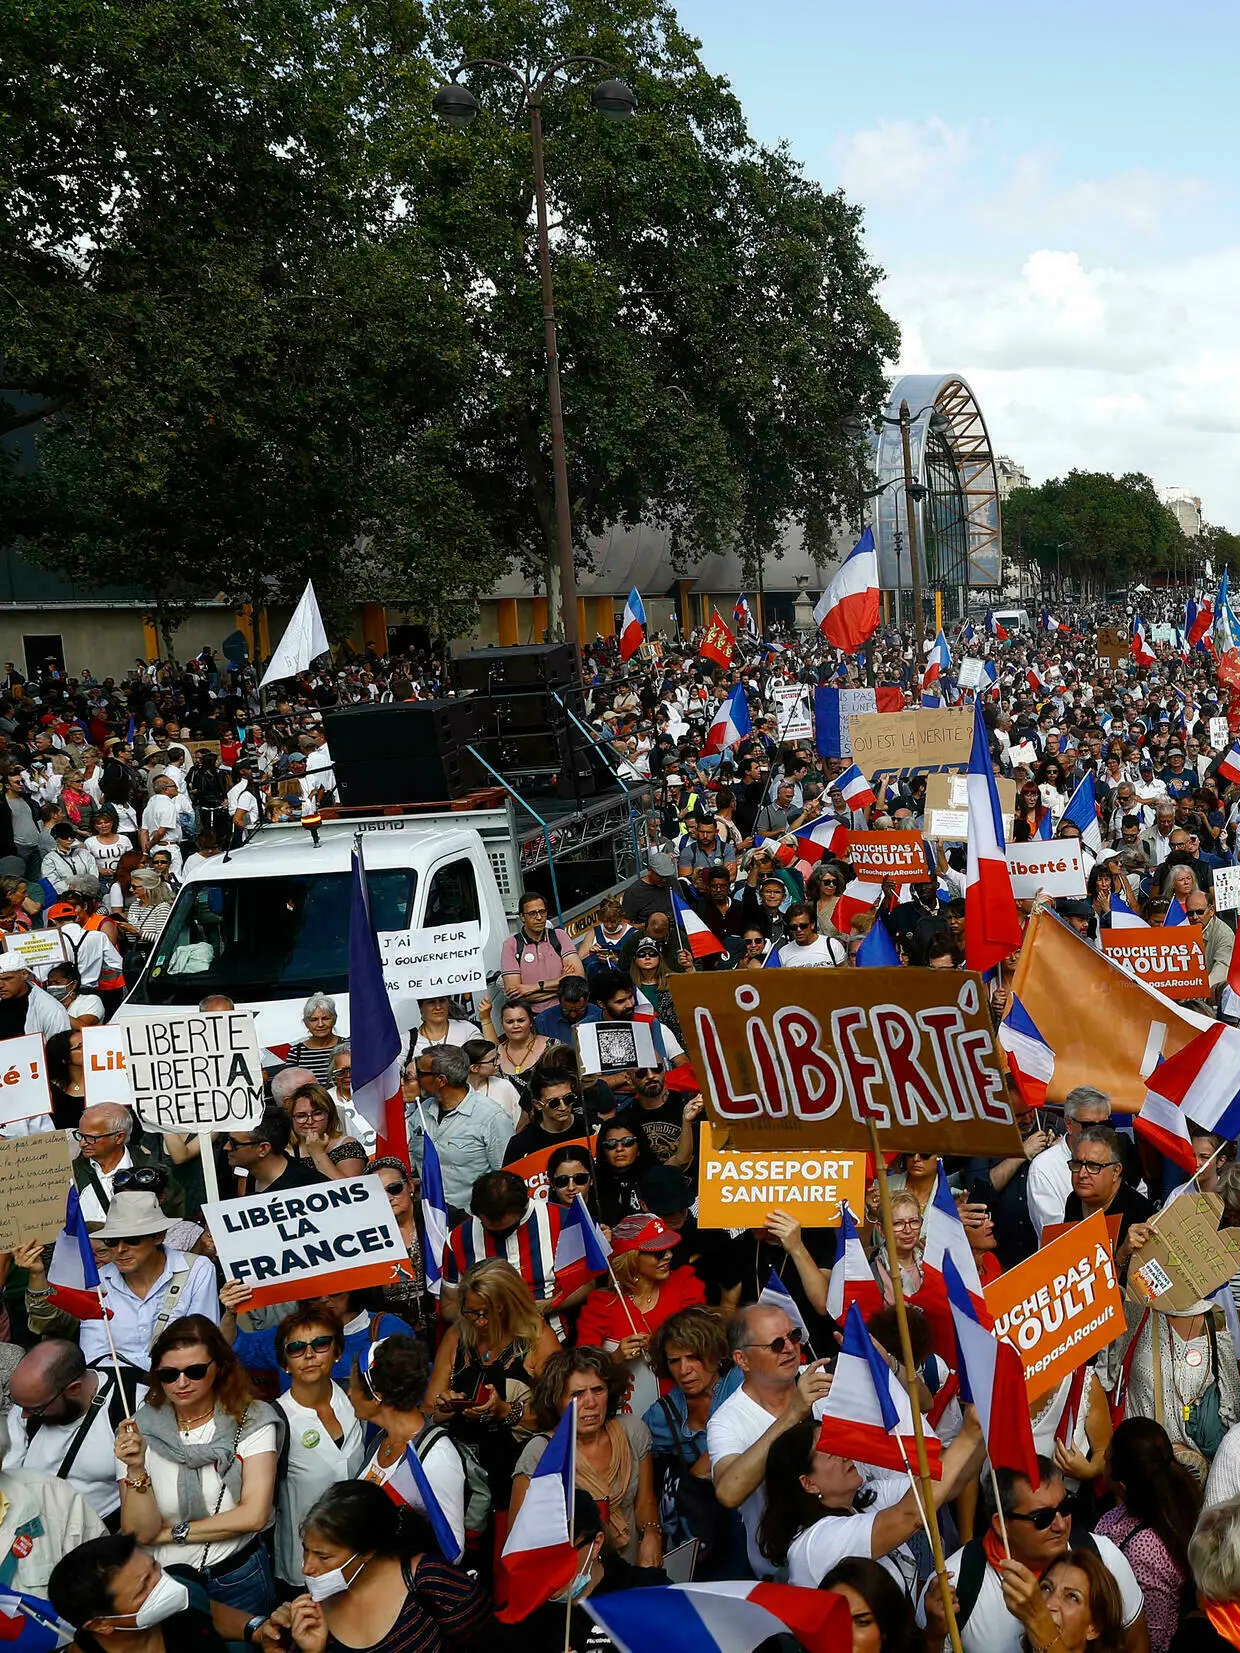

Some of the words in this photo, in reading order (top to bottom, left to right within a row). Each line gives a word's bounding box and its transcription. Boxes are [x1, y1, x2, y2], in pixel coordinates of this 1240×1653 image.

[877, 734, 897, 749] EST
[901, 731, 915, 747] LA
[850, 843, 889, 853] TOUCHE
[890, 844, 912, 852] PAS
[1008, 858, 1067, 876] iberté
[1072, 858, 1079, 871] !
[433, 931, 467, 945] PEUR
[395, 947, 480, 966] GOUVERNEMENT
[1106, 945, 1157, 957] TOUCHE
[1161, 944, 1189, 954] PAS
[1191, 941, 1203, 955] À
[1198, 956, 1205, 970] !
[408, 979, 423, 989] DE
[430, 977, 443, 986] LA
[126, 1014, 250, 1056] LIBERTE
[132, 1052, 254, 1091] LIBERTA
[136, 1086, 265, 1126] FREEDOM
[706, 1160, 854, 1181] PASSEPORT
[720, 1185, 838, 1203] SANITAIRE
[222, 1183, 370, 1233] LIBÉRONS
[277, 1217, 320, 1242] LA
[229, 1224, 395, 1286] FRANCE!
[992, 1285, 1051, 1336] UCHE
[1053, 1254, 1092, 1294] PAS
[1093, 1242, 1110, 1269] À
[1002, 1271, 1097, 1354] OULT
[1104, 1262, 1117, 1291] !
[1024, 1304, 1115, 1382] hepasARaoult
